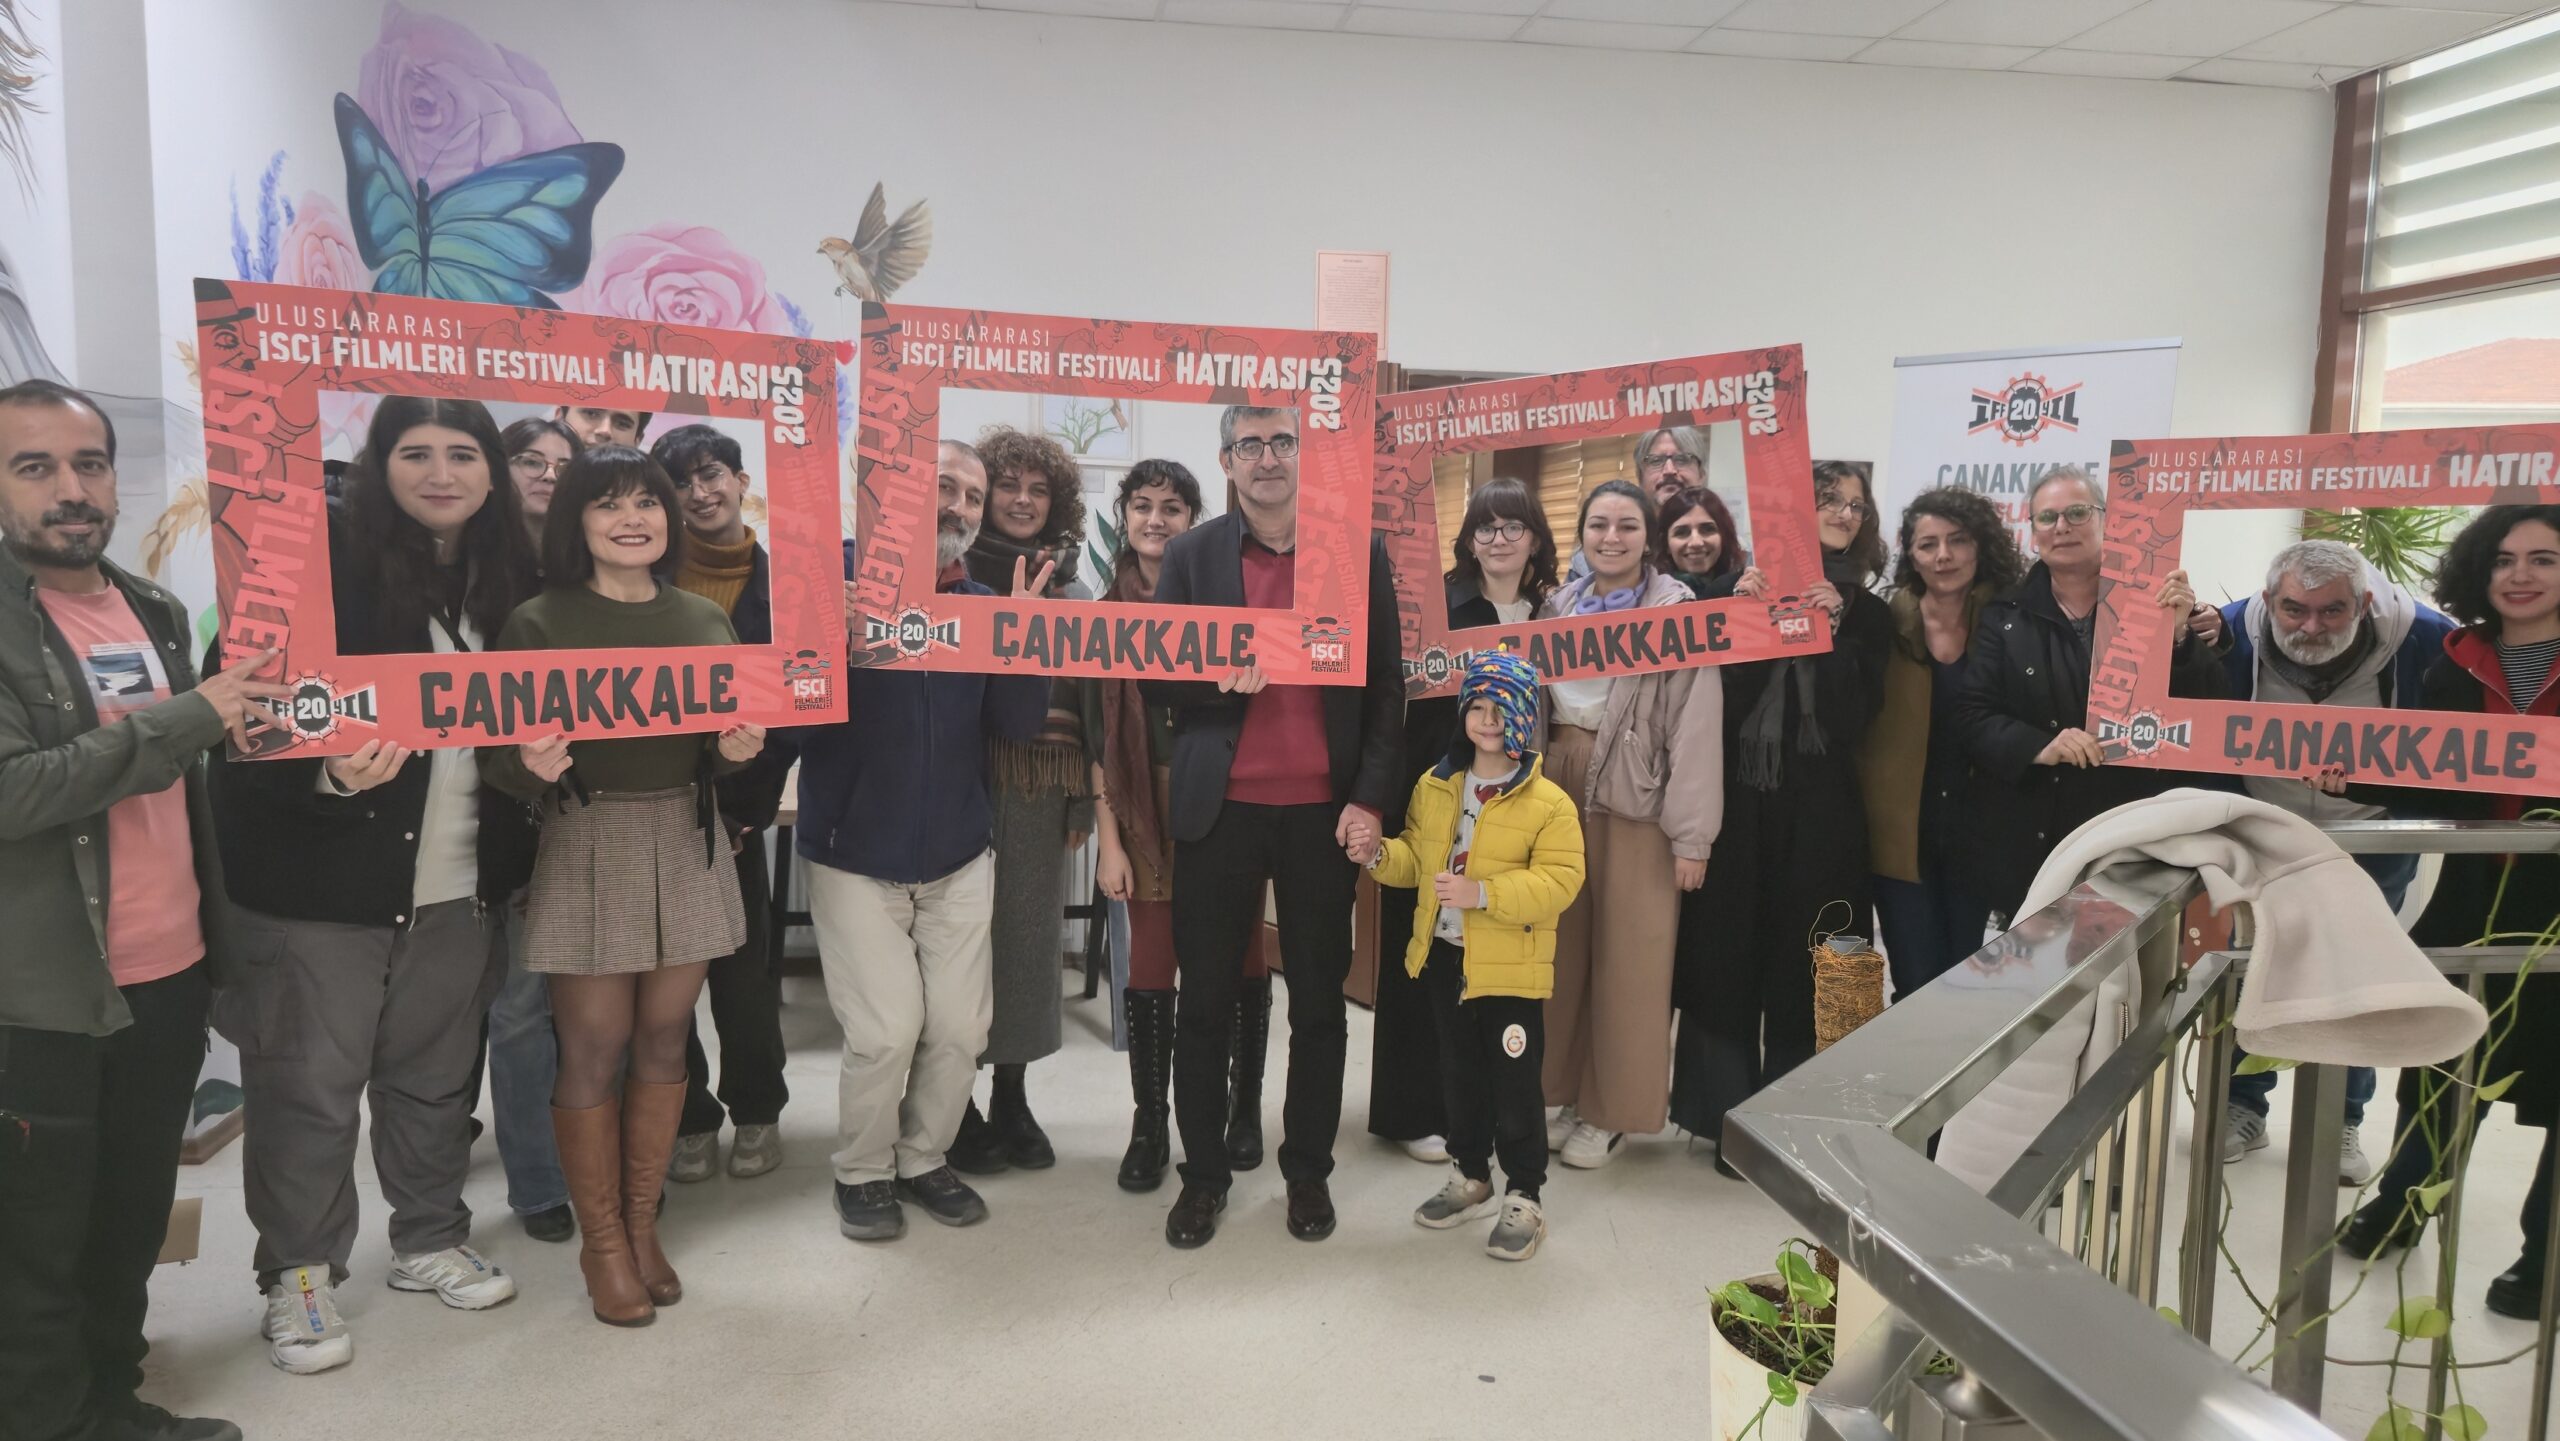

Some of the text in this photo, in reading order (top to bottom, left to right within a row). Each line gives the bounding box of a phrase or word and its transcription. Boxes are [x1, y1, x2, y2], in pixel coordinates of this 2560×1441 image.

[256, 302, 462, 339] ULUSLARARASI
[902, 320, 1049, 347] ULUSLARARASI
[333, 336, 466, 376] FİLMLERİ
[477, 348, 605, 385] FESTİVALİ
[623, 351, 768, 400] HATIRASI
[953, 345, 1049, 375] FİLMLERİ
[1058, 353, 1160, 382] FESTİVALİ
[1176, 351, 1307, 390] HATIRASI
[772, 366, 806, 446] 2025
[1310, 358, 1342, 430] 2025
[1393, 392, 1517, 421] ULUSLARARASI
[1438, 410, 1520, 440] FİLMLERİ
[1526, 399, 1615, 429] FESTİVALİ
[1627, 375, 1744, 417] HATIRASI
[1745, 371, 1777, 436] 2025
[2010, 399, 2038, 421] 20.
[2042, 391, 2080, 427] YIL
[2149, 448, 2303, 467] ULUSLARARASI
[2198, 468, 2303, 494] FİLMLERİ
[2310, 464, 2431, 491] FESTİVALİ
[2449, 452, 2560, 487] HATIR
[220, 478, 322, 678] FİLMLER
[903, 623, 926, 641] 20.
[993, 612, 1256, 673] ÇANAKKALE
[1427, 659, 1447, 674] 20.
[297, 697, 330, 720] 20.
[420, 664, 737, 738] ÇANAKKALE
[2133, 725, 2155, 741] 20.
[2224, 715, 2537, 782] ÇANAKKALE
